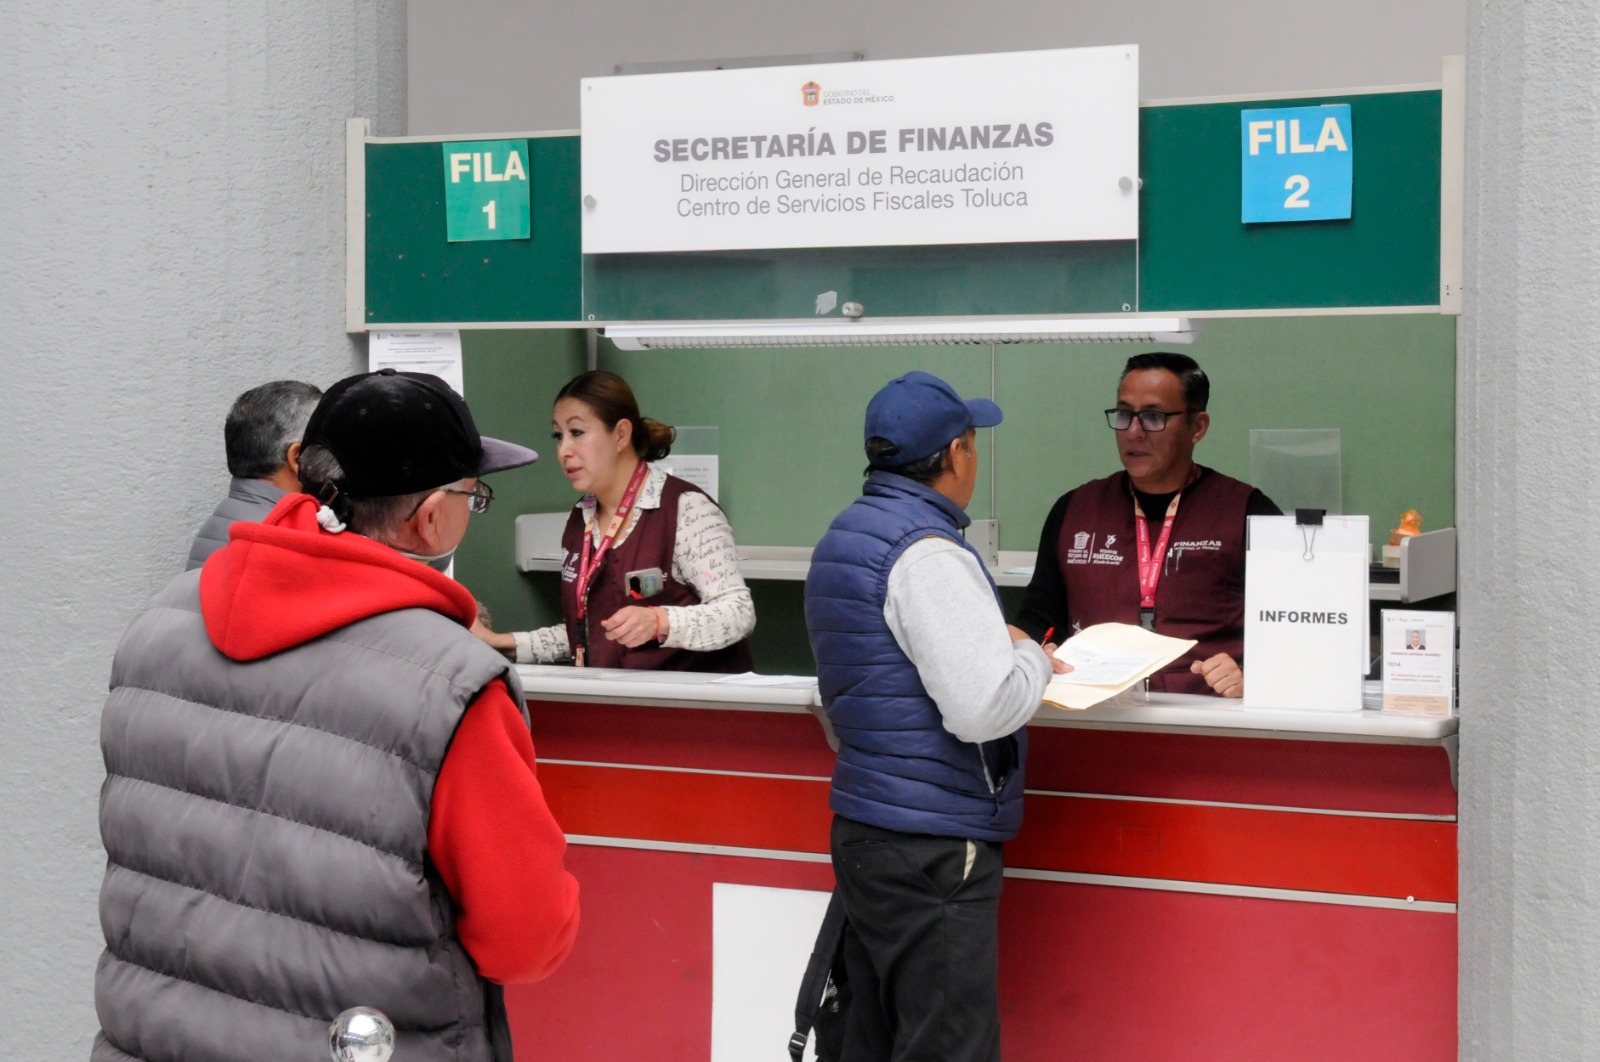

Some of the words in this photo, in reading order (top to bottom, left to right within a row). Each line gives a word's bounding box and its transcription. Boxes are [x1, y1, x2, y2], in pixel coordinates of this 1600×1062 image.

[823, 89, 858, 98] GOBIERNO
[858, 88, 872, 96] DEL
[823, 97, 852, 106] ESTADO
[853, 96, 864, 104] DE
[865, 94, 895, 103] MÉXICO
[653, 126, 836, 163] SECRETARÍA
[847, 130, 887, 155] DE
[899, 121, 1054, 152] FINANZAS
[1249, 117, 1348, 155] FILA
[450, 150, 526, 183] FILA
[680, 171, 768, 192] Dirección
[775, 168, 850, 189] General
[858, 167, 883, 186] de
[890, 161, 1023, 185] Recaudación
[677, 197, 740, 217] Centro
[746, 195, 770, 214] de
[777, 193, 866, 214] Servicios
[873, 190, 954, 210] Fiscales
[961, 187, 1029, 208] Toluca
[1284, 174, 1310, 208] 2
[482, 200, 496, 229] 1
[1173, 540, 1222, 548] FINANZAS
[1259, 609, 1348, 625] INFORMES
